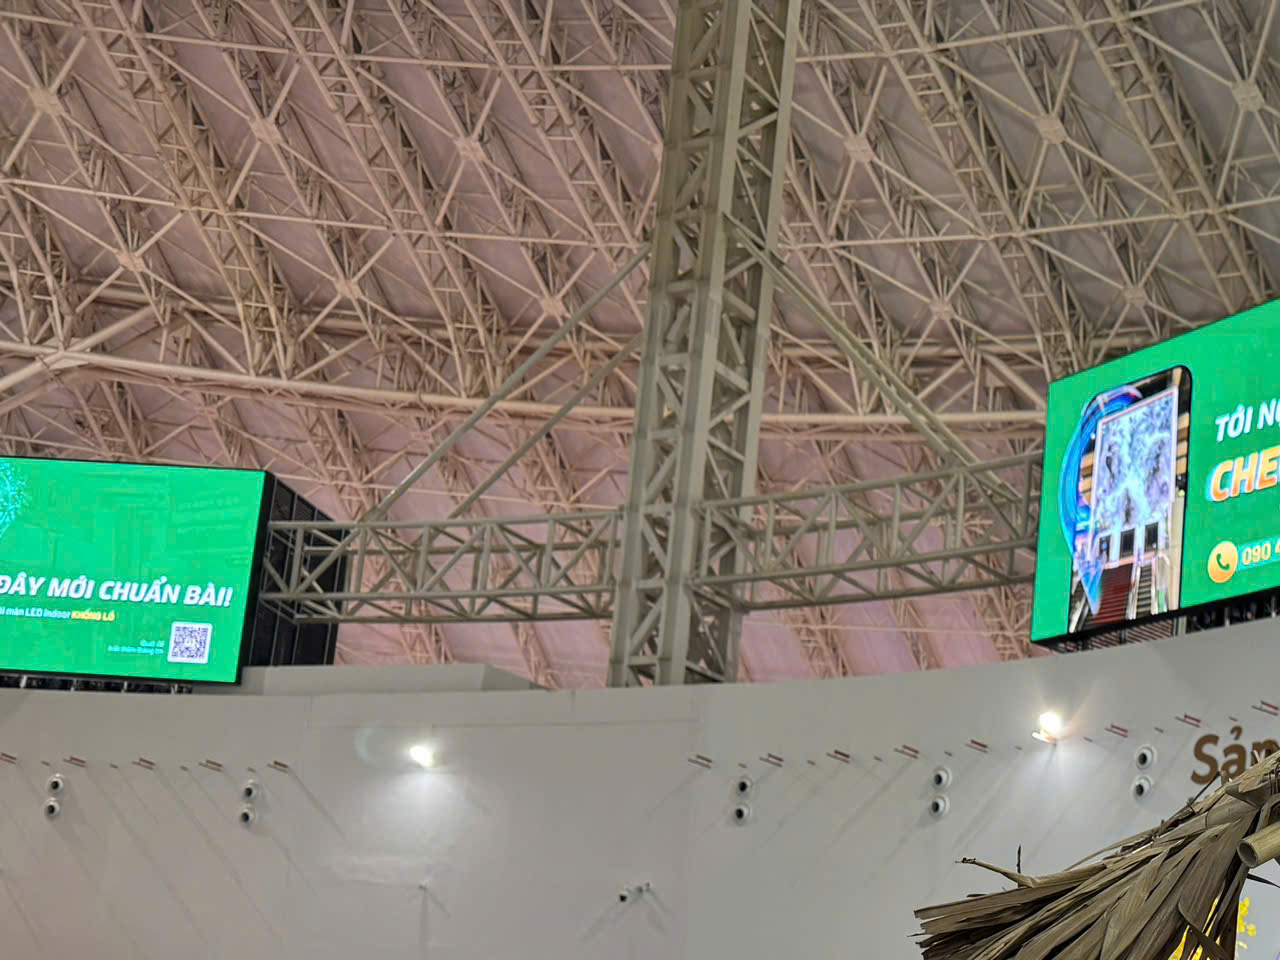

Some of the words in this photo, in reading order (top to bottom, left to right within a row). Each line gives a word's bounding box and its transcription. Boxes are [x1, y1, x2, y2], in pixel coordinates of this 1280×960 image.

[1215, 403, 1253, 442] TỚI
[1242, 541, 1271, 566] 090
[47, 575, 95, 599] MỚI
[99, 575, 181, 604] CHUẨN
[184, 582, 233, 608] BÀI!
